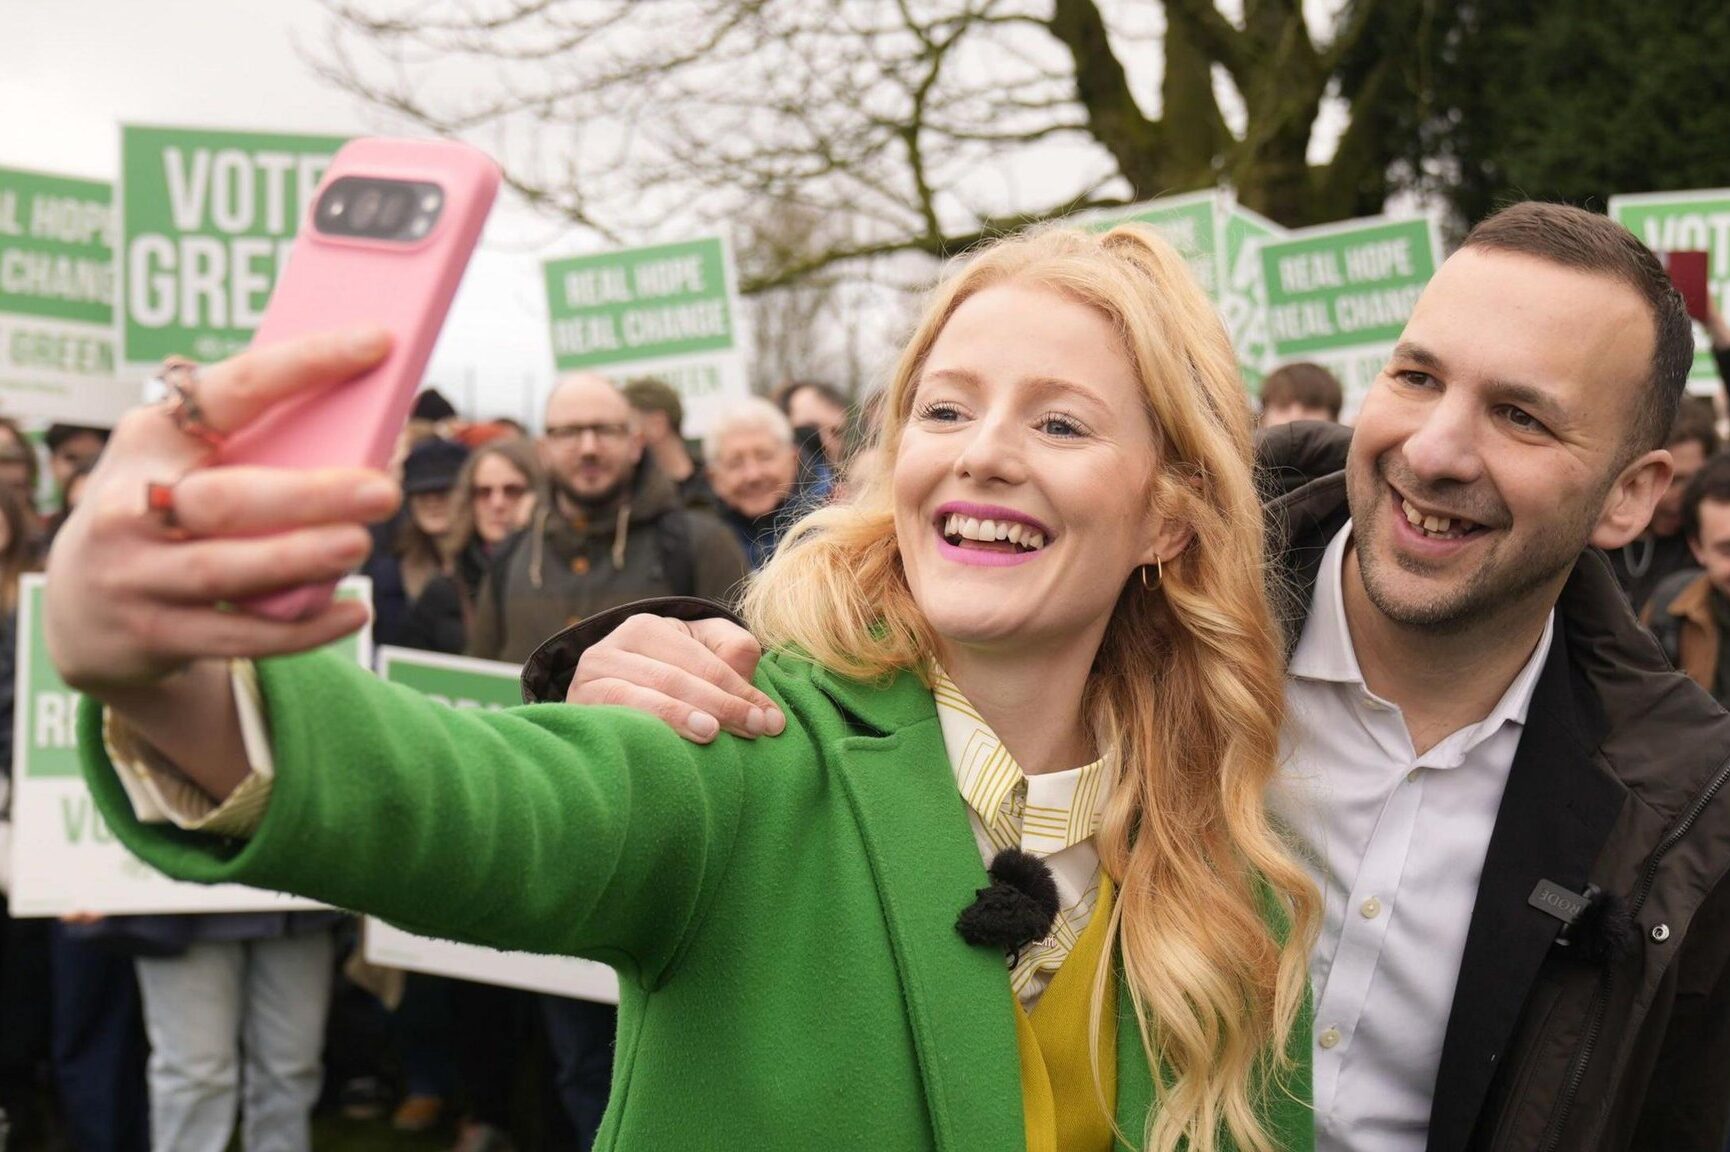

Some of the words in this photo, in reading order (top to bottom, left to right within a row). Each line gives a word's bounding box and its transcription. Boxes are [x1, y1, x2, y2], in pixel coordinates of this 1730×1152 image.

[1278, 252, 1343, 293] REAL
[1346, 238, 1416, 281] HOPE
[1644, 213, 1730, 277] VOT
[129, 232, 292, 328] GRE
[565, 268, 632, 308] REAL
[635, 255, 705, 297] HOPE
[554, 316, 621, 355] REAL
[623, 300, 727, 346] CHANGE
[1271, 301, 1335, 340] REAL
